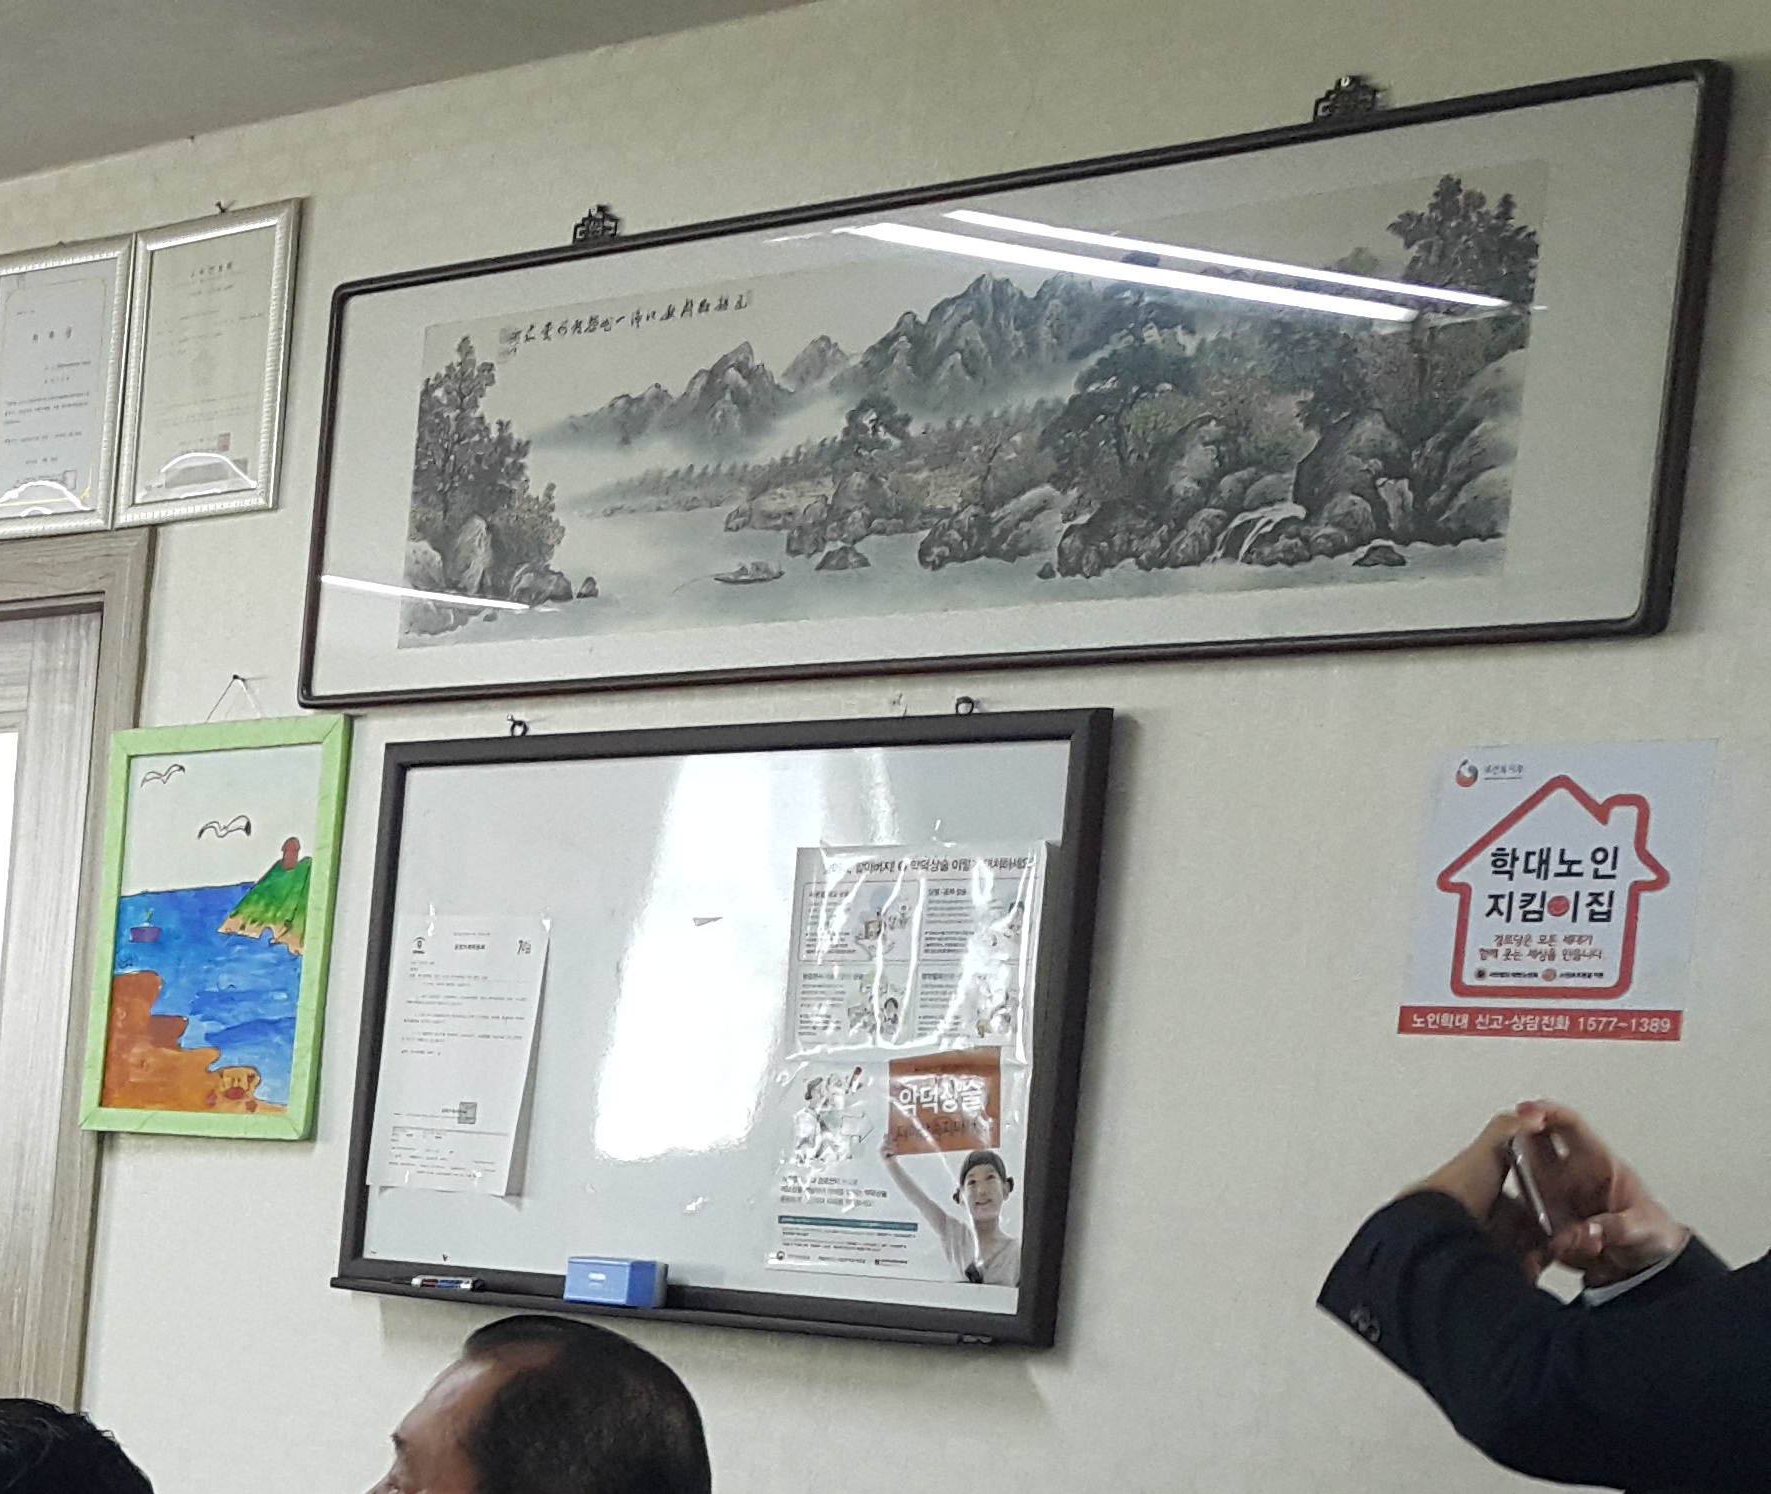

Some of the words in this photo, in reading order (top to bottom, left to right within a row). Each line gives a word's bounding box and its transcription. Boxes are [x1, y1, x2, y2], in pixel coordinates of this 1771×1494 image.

[1490, 845, 1619, 881] 학대노인
[1484, 889, 1616, 924] 지킴이집
[1411, 1012, 1470, 1030] 노인학대
[1577, 1016, 1672, 1034] 1577-1389
[898, 1076, 983, 1119] 악덕상술
